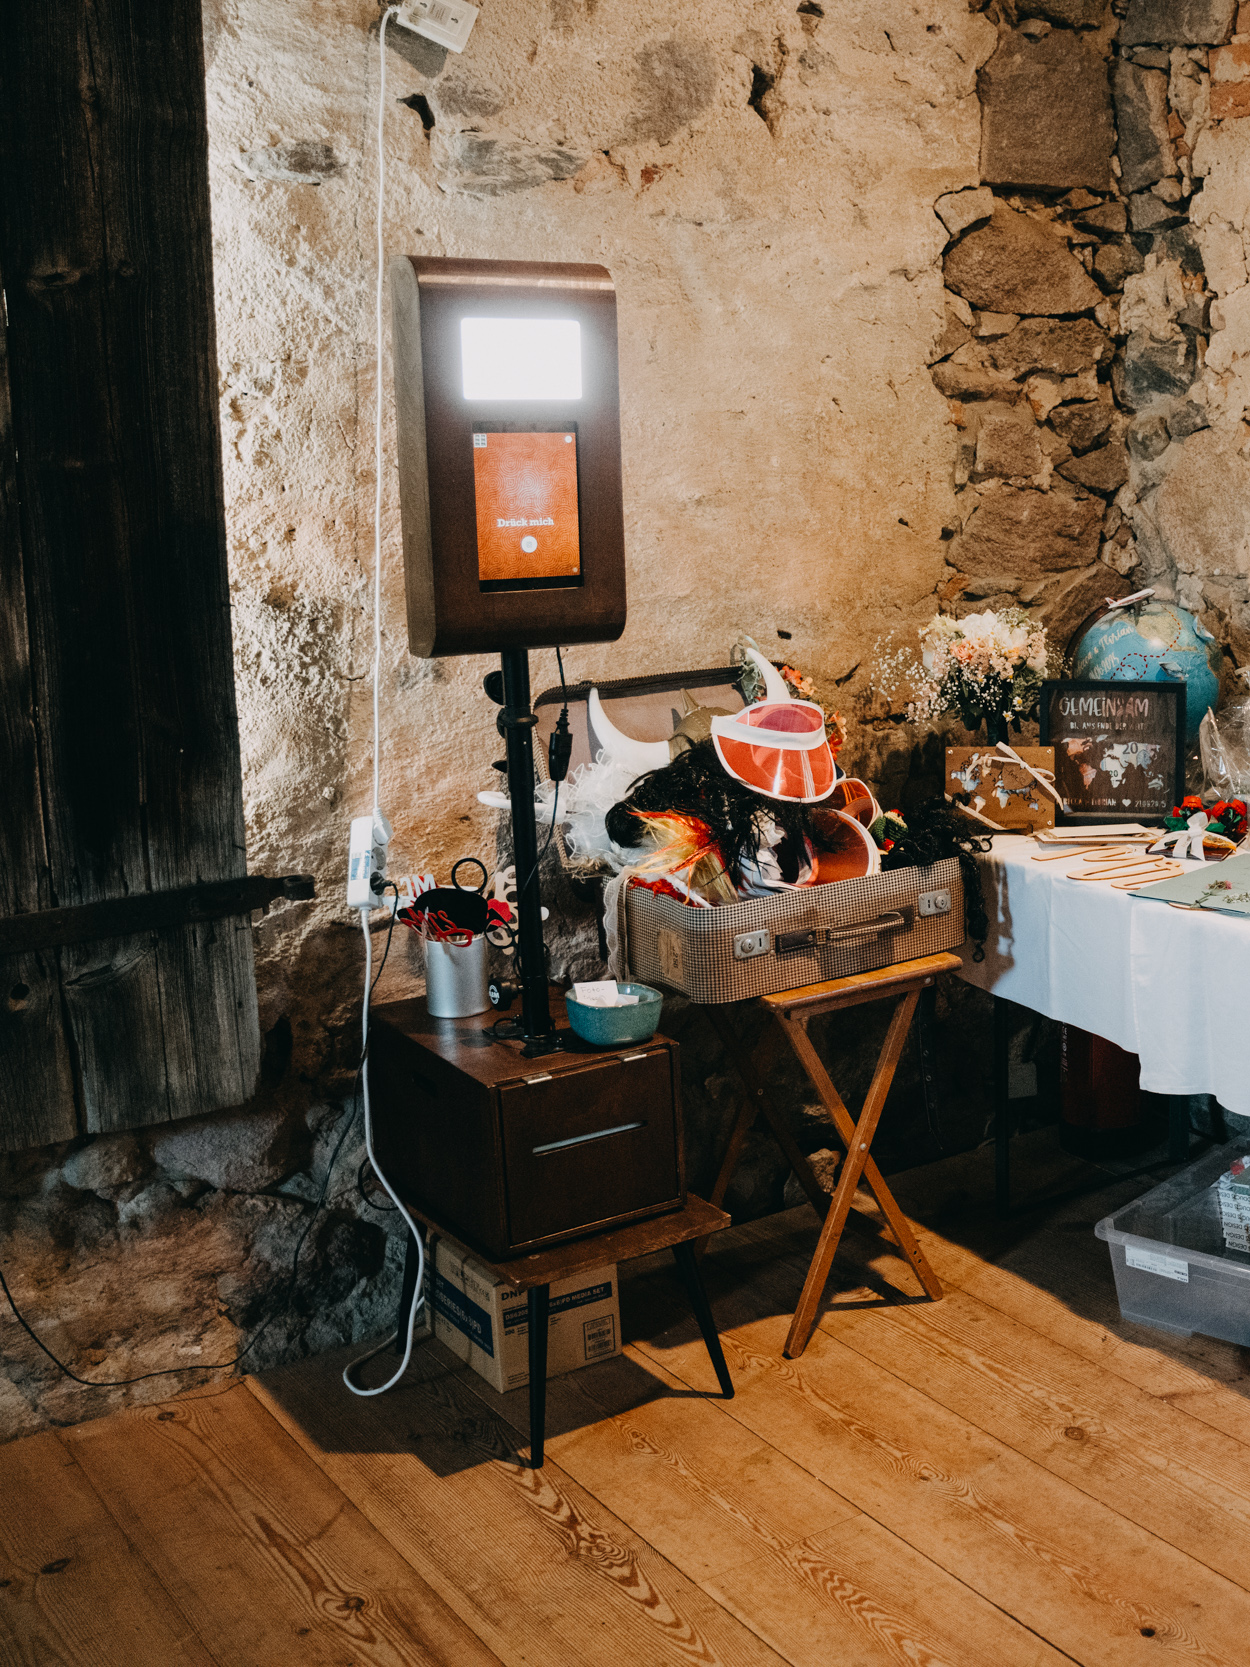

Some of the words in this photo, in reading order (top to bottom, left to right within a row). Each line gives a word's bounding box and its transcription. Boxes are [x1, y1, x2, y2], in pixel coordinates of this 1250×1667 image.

[496, 518, 527, 528] Drück
[529, 516, 554, 526] mich
[1099, 625, 1134, 650] Florian
[1122, 741, 1139, 755] 20
[571, 1291, 592, 1301] MEDIA
[592, 1286, 605, 1295] SET
